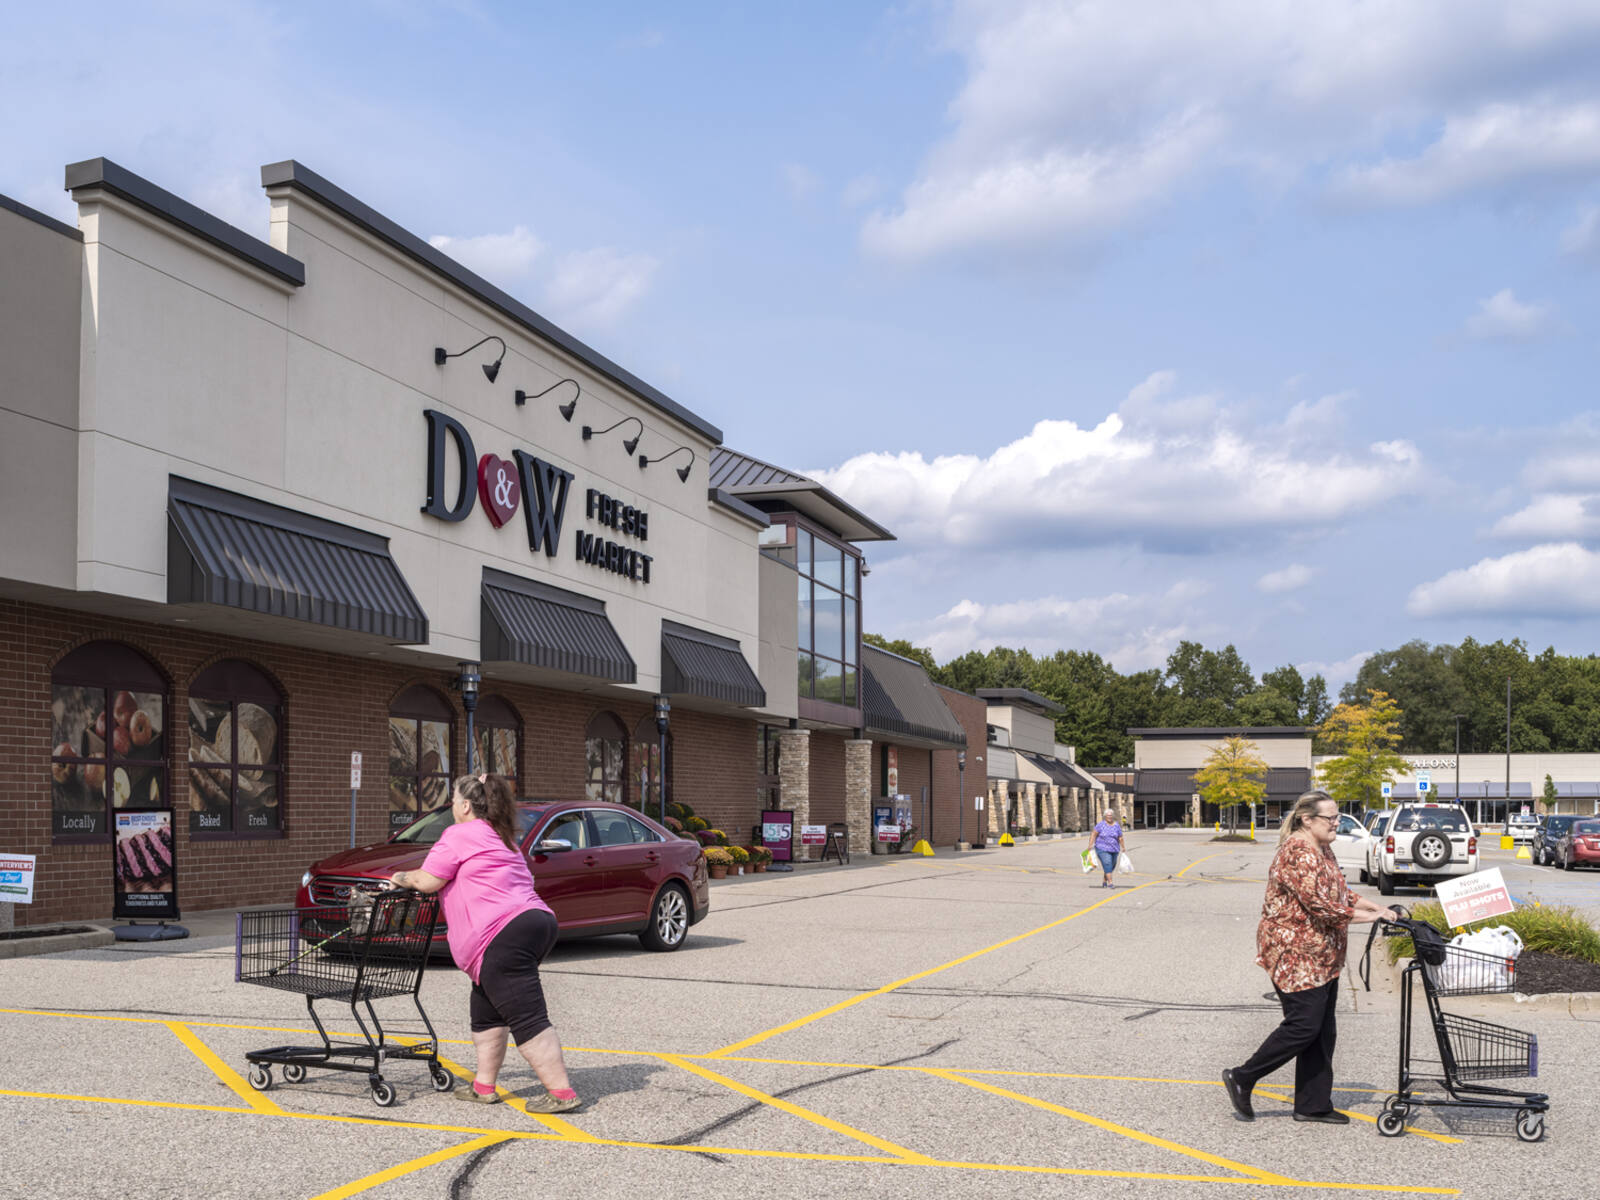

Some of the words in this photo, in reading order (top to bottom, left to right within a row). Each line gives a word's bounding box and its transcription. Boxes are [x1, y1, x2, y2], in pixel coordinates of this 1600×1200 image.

[586, 488, 649, 541] FRESH
[576, 530, 654, 584] MARKET
[62, 814, 96, 833] Locally
[199, 813, 221, 827] Baked
[248, 812, 268, 826] Fresh
[780, 824, 790, 839] 5
[1453, 882, 1492, 898] Available
[1459, 878, 1480, 887] Now
[1448, 901, 1468, 914] FLU
